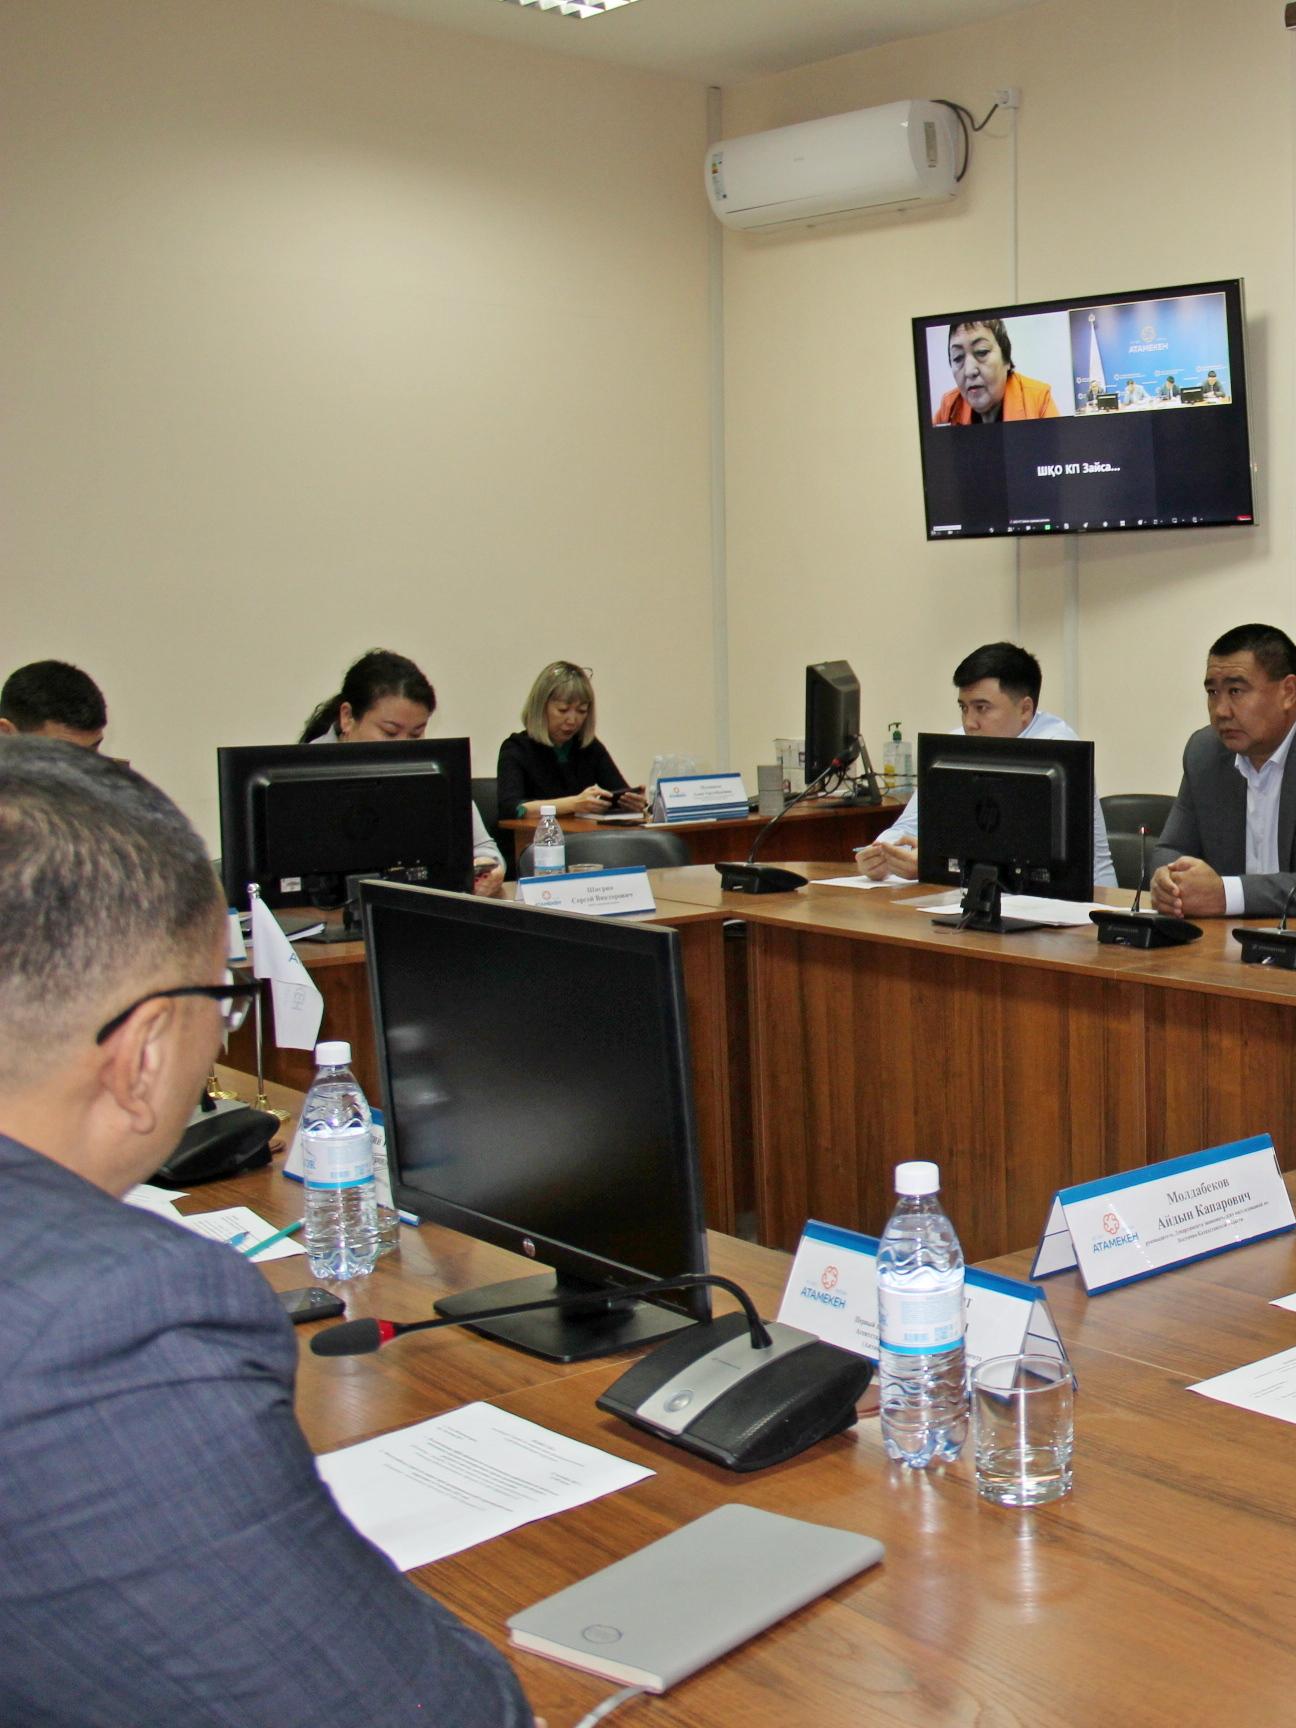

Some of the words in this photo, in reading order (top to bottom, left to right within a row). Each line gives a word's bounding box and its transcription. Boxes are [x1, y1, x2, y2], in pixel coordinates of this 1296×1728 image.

[1037, 465, 1063, 477] ШҚО
[1065, 463, 1080, 475] КП
[1166, 1178, 1230, 1205] Молдабеков
[1158, 1209, 1193, 1230] Айдын
[1194, 1191, 1251, 1218] Капарович
[1093, 1231, 1139, 1254] АТАМЕКЕН
[801, 1286, 846, 1309] АТАМЕКЕН
